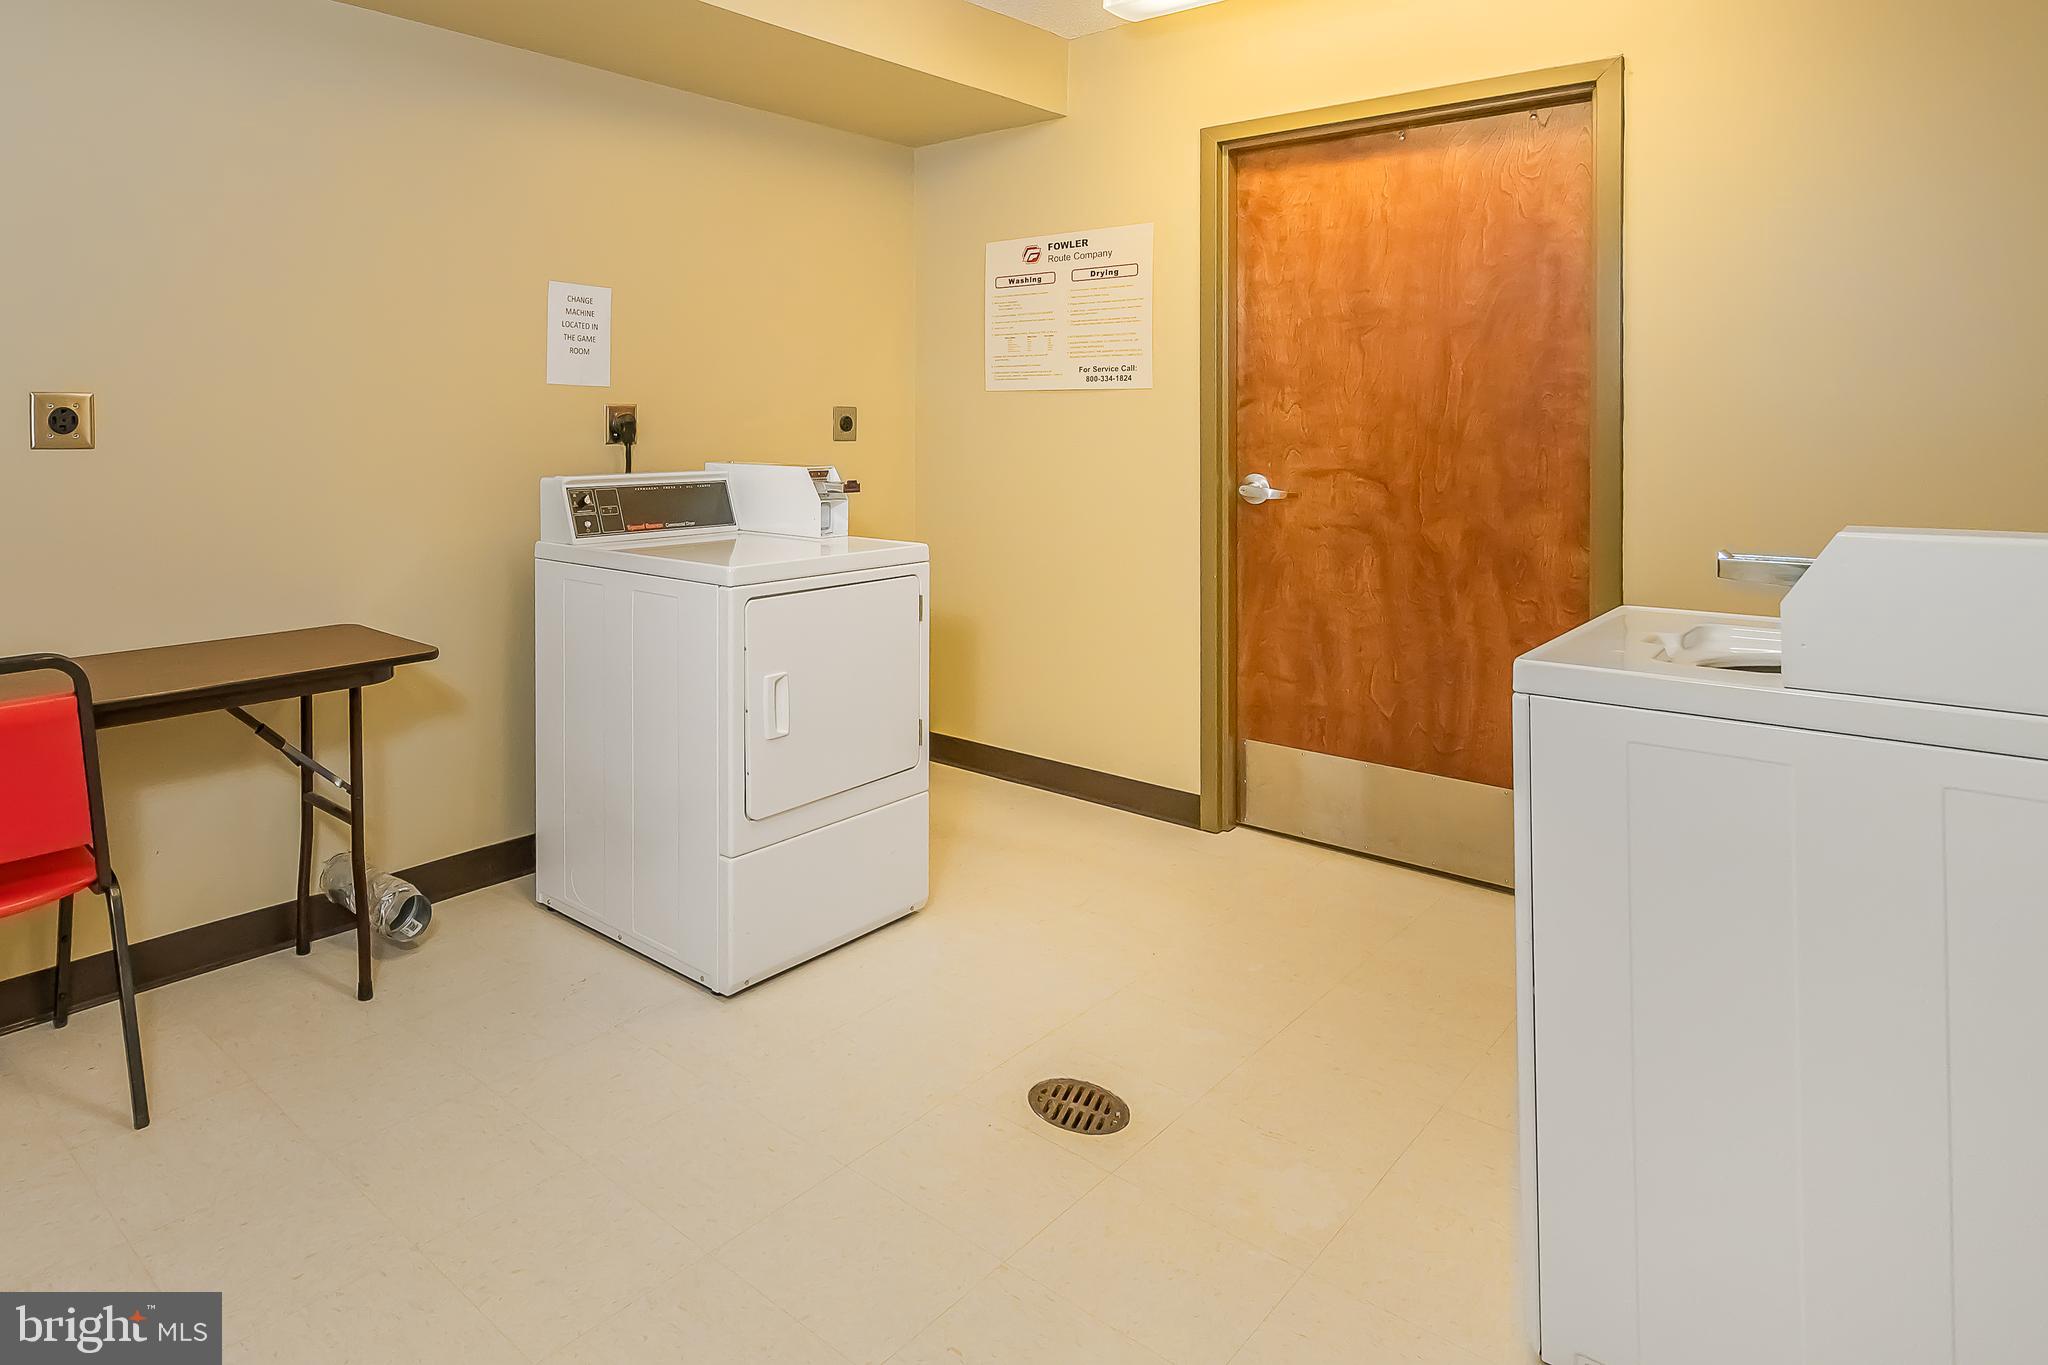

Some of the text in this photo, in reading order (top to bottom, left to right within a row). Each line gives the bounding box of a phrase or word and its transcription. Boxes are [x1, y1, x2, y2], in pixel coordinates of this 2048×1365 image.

[1047, 238, 1089, 251] FOWLER
[1047, 249, 1113, 263] Route Company
[1090, 268, 1119, 278] Drying
[1008, 276, 1042, 285] Washing
[567, 295, 593, 305] CHANGE
[565, 308, 595, 317] MACHINE
[561, 321, 590, 330] LOCATED
[577, 335, 596, 343] GAME
[569, 347, 590, 355] ROOM
[1078, 364, 1138, 373] For Service Call:
[1085, 374, 1132, 382] 800-334-1824
